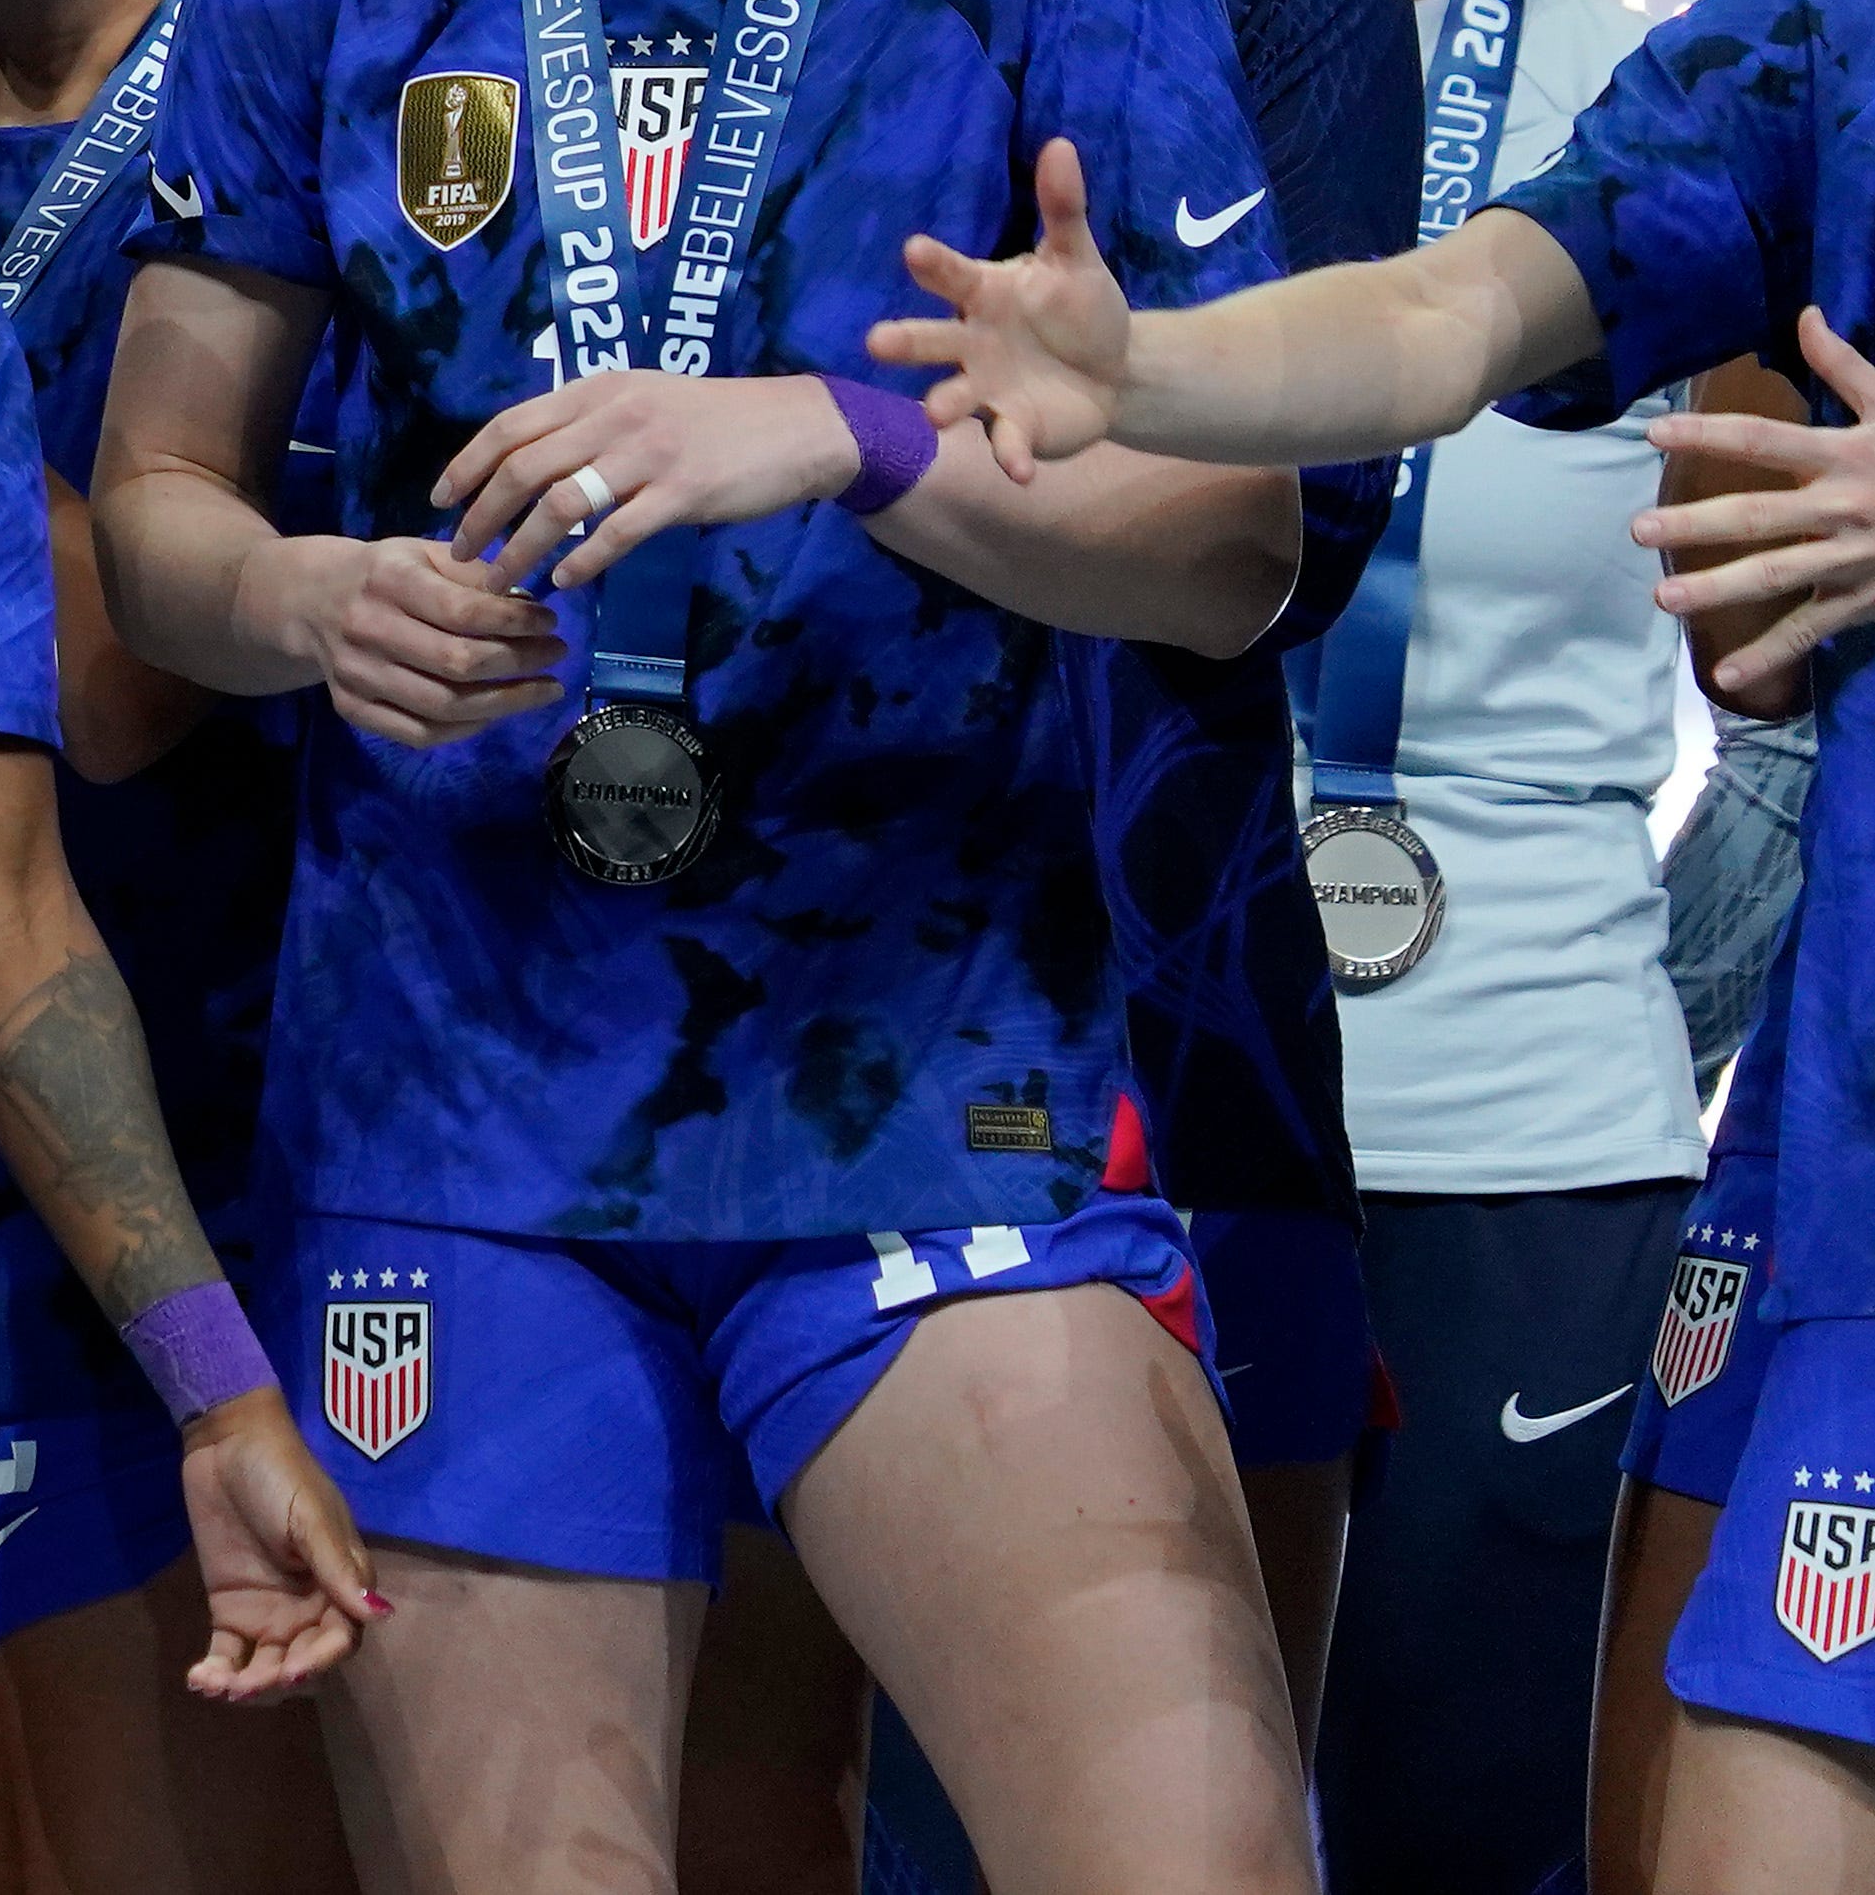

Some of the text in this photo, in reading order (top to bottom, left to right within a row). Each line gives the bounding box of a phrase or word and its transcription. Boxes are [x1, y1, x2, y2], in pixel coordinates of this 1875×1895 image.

[428, 182, 477, 205] FIFA
[435, 213, 467, 227] 2019
[1310, 881, 1418, 906] CHAMPION
[1674, 1262, 1741, 1323] USA
[331, 1310, 422, 1368] USA
